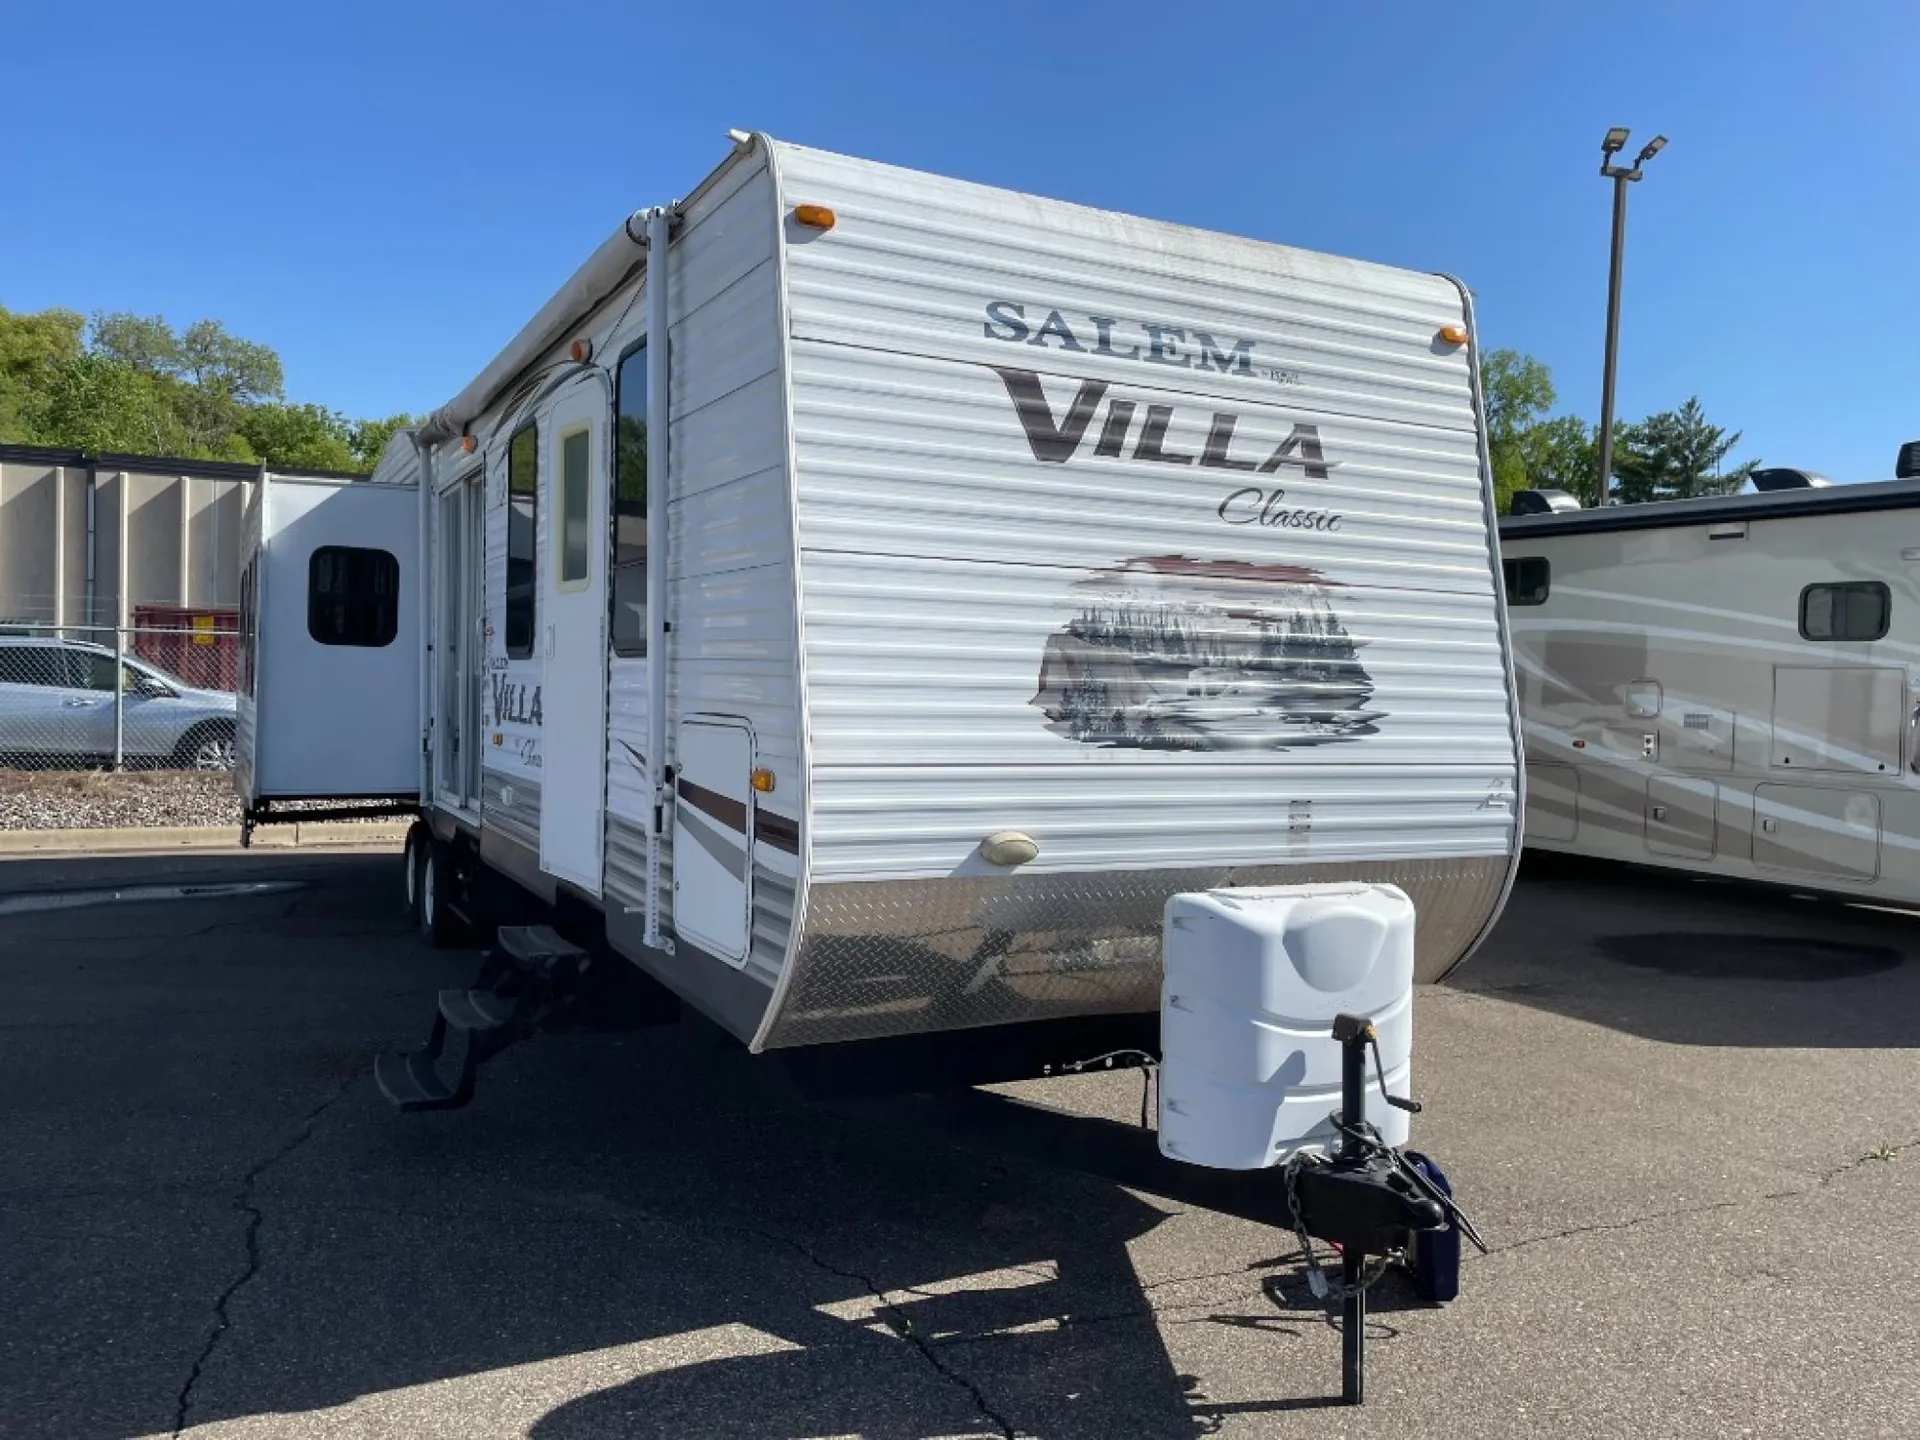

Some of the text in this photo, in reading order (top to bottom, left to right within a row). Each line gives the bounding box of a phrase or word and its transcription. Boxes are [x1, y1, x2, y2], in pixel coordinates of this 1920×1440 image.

[984, 301, 1258, 378] SALEM
[988, 365, 1343, 480] VILLA
[1217, 486, 1345, 533] Classic
[492, 672, 543, 727] VILLA
